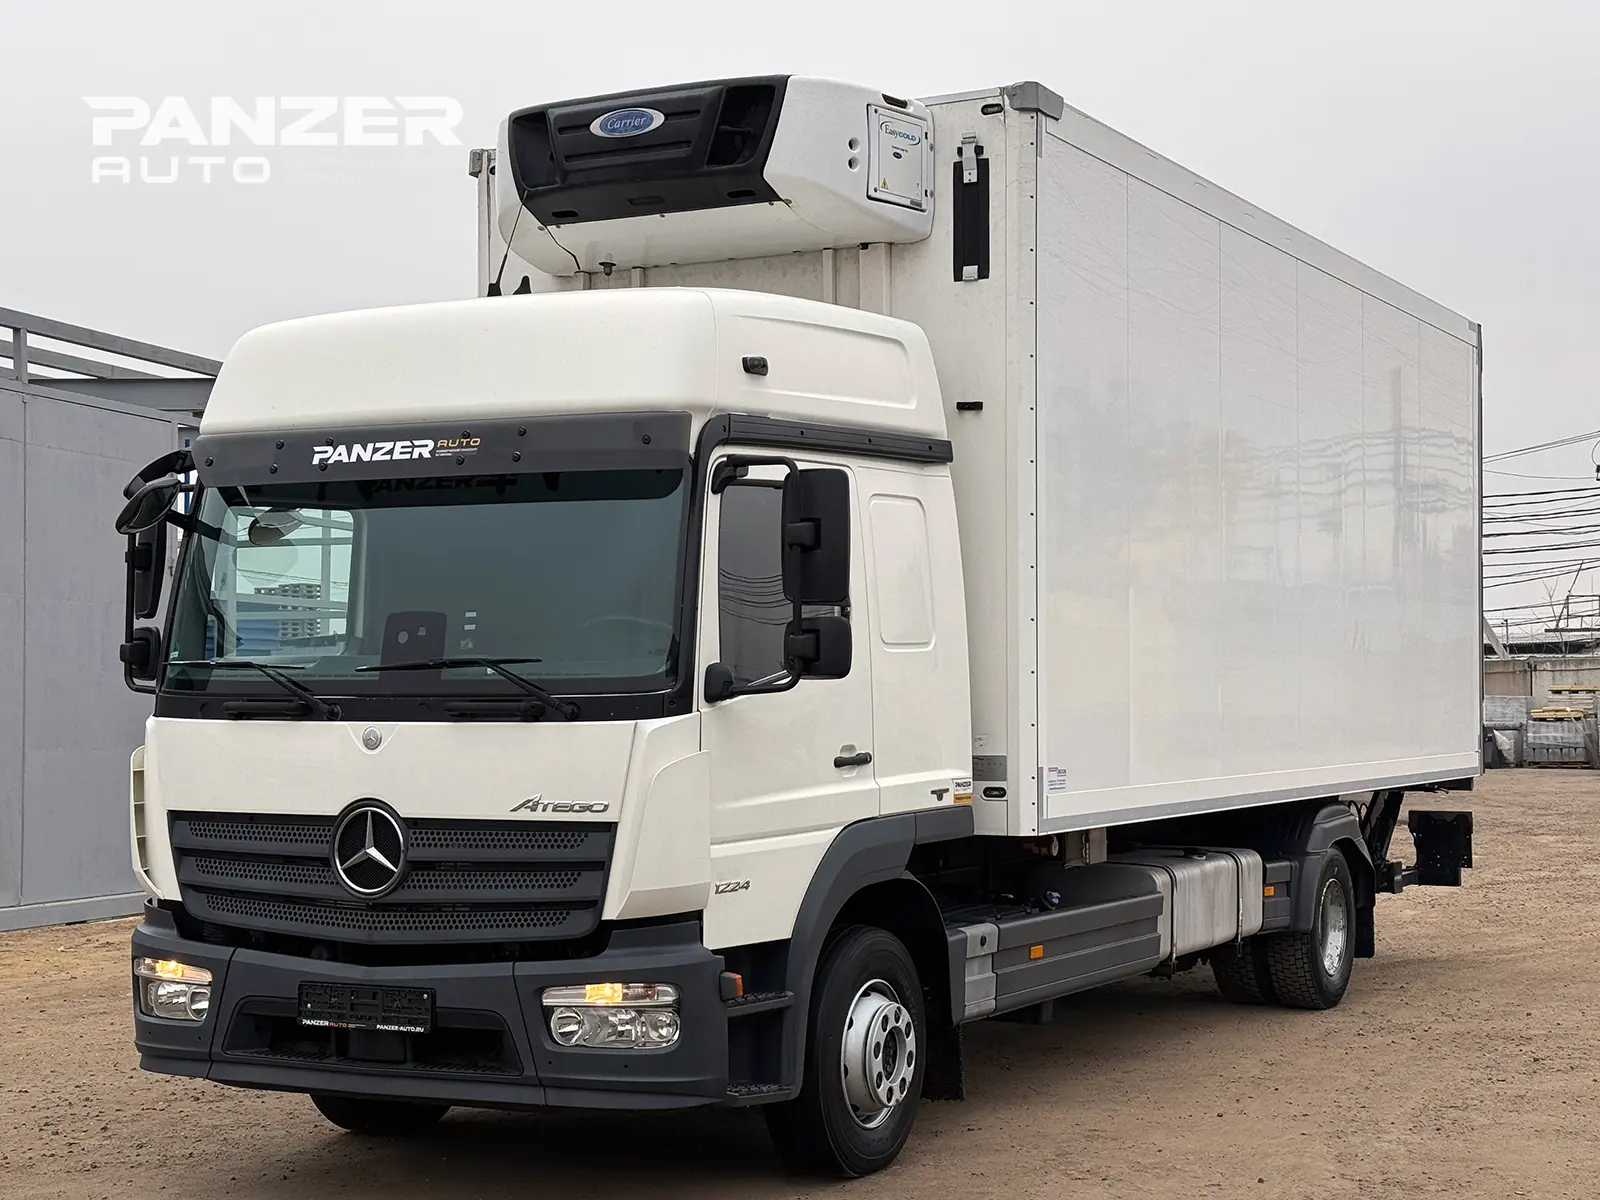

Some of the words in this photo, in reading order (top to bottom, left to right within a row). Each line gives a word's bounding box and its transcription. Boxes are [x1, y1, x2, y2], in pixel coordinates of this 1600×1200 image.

[607, 116, 647, 130] Carrier
[311, 439, 435, 466] PANZER
[437, 438, 481, 448] AUTO
[714, 879, 751, 895] 1224
[302, 1018, 329, 1027] PANZER
